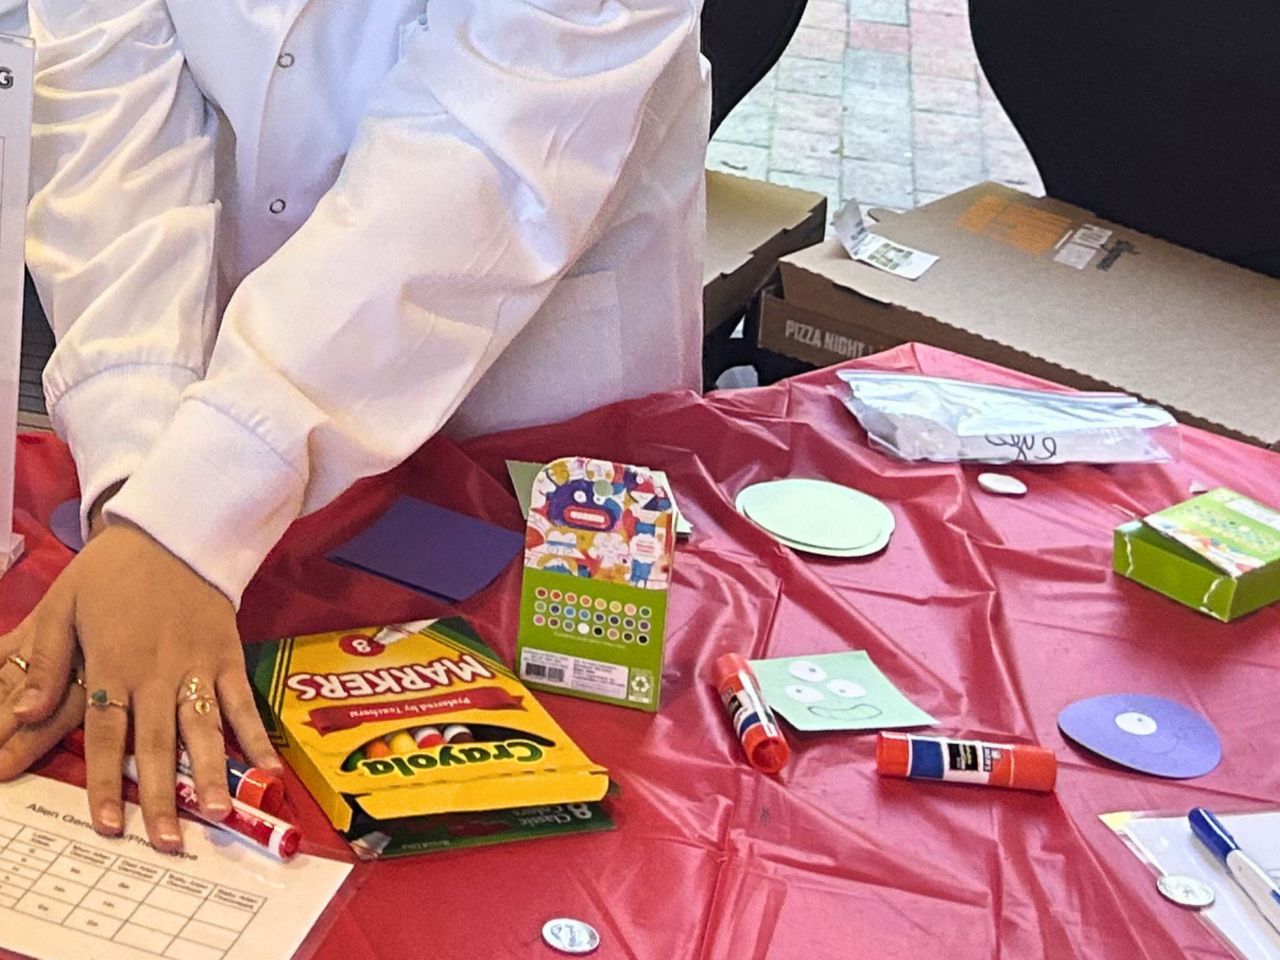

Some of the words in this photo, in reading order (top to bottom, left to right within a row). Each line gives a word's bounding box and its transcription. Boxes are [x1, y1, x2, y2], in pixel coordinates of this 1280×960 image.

[785, 319, 822, 348] PIZZA
[823, 331, 865, 358] NIGHT
[351, 638, 372, 655] 8
[285, 654, 494, 701] MARKERS
[404, 701, 422, 716] by
[423, 697, 471, 714] Preferred
[360, 740, 544, 777] Crayola
[25, 802, 60, 820] Alien
